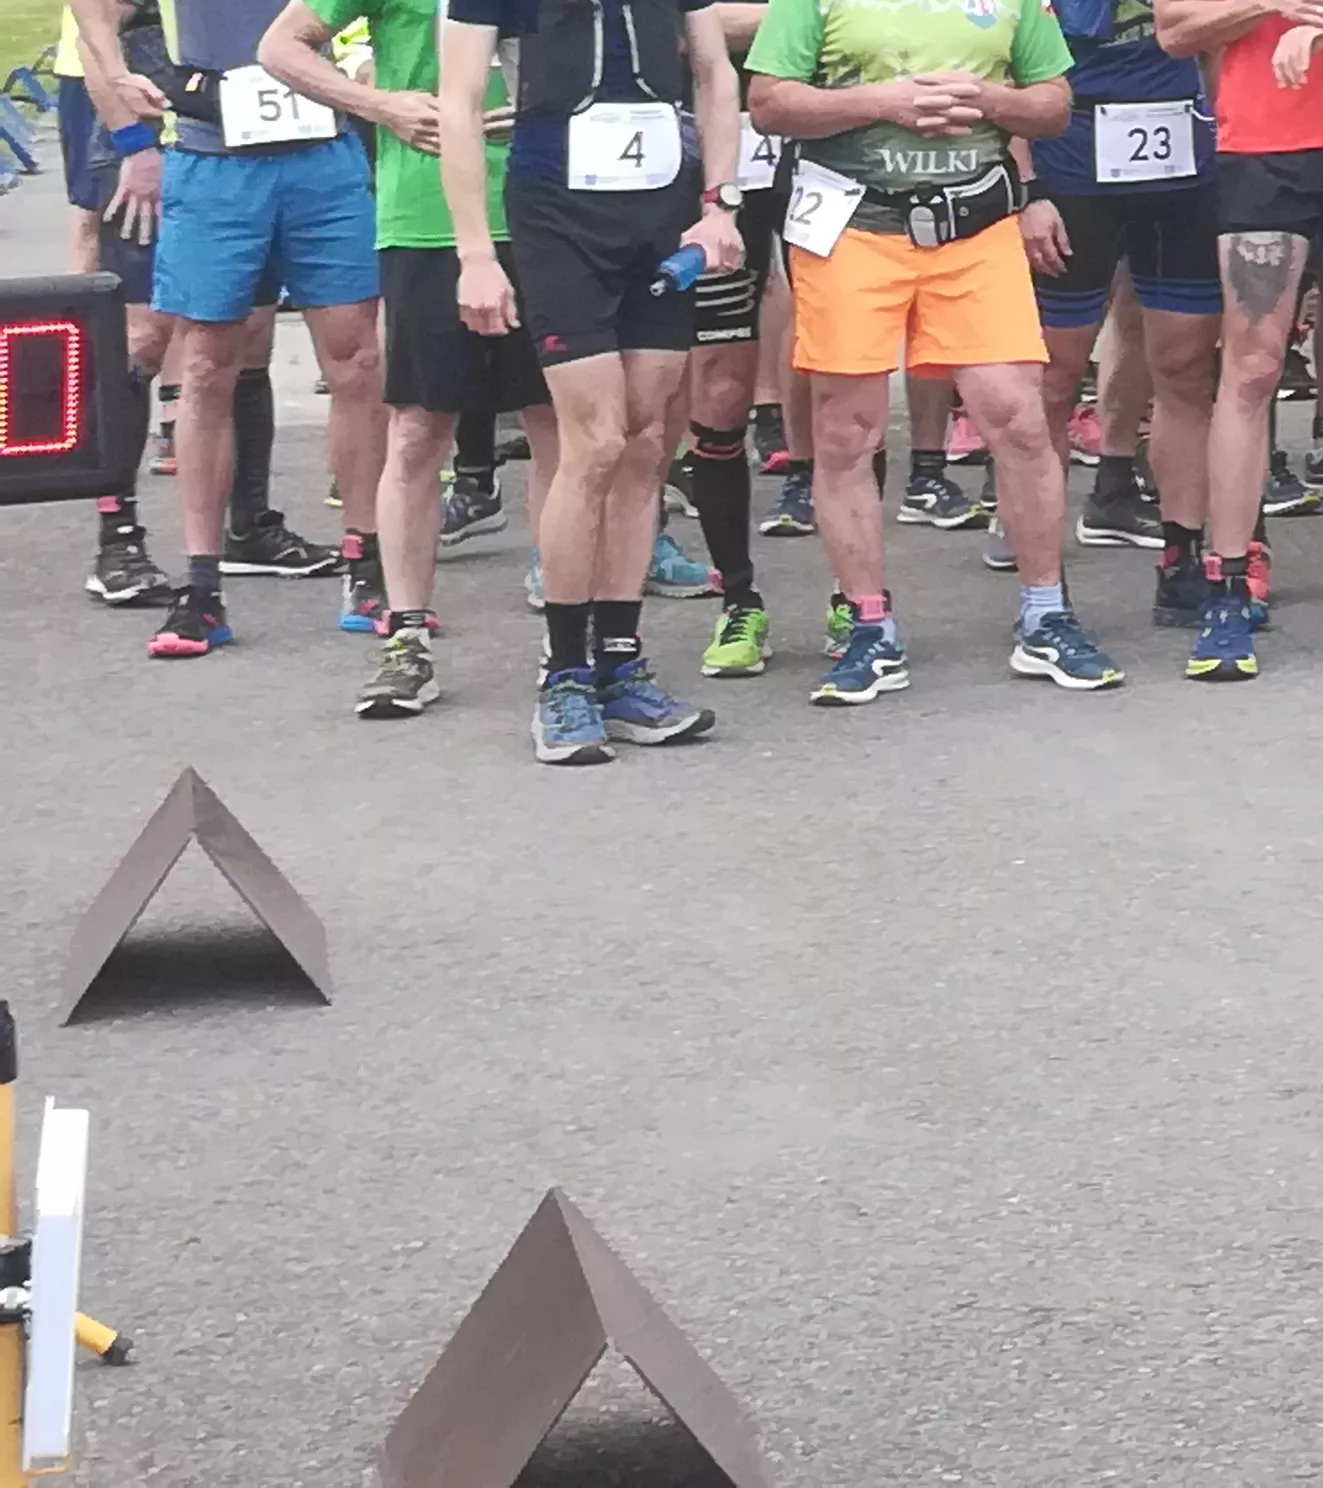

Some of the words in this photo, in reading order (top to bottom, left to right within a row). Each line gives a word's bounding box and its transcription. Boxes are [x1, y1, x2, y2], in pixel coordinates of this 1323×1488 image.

[257, 88, 300, 122] 51
[616, 131, 646, 168] 4
[1128, 126, 1172, 161] 23
[873, 148, 978, 174] WILKI
